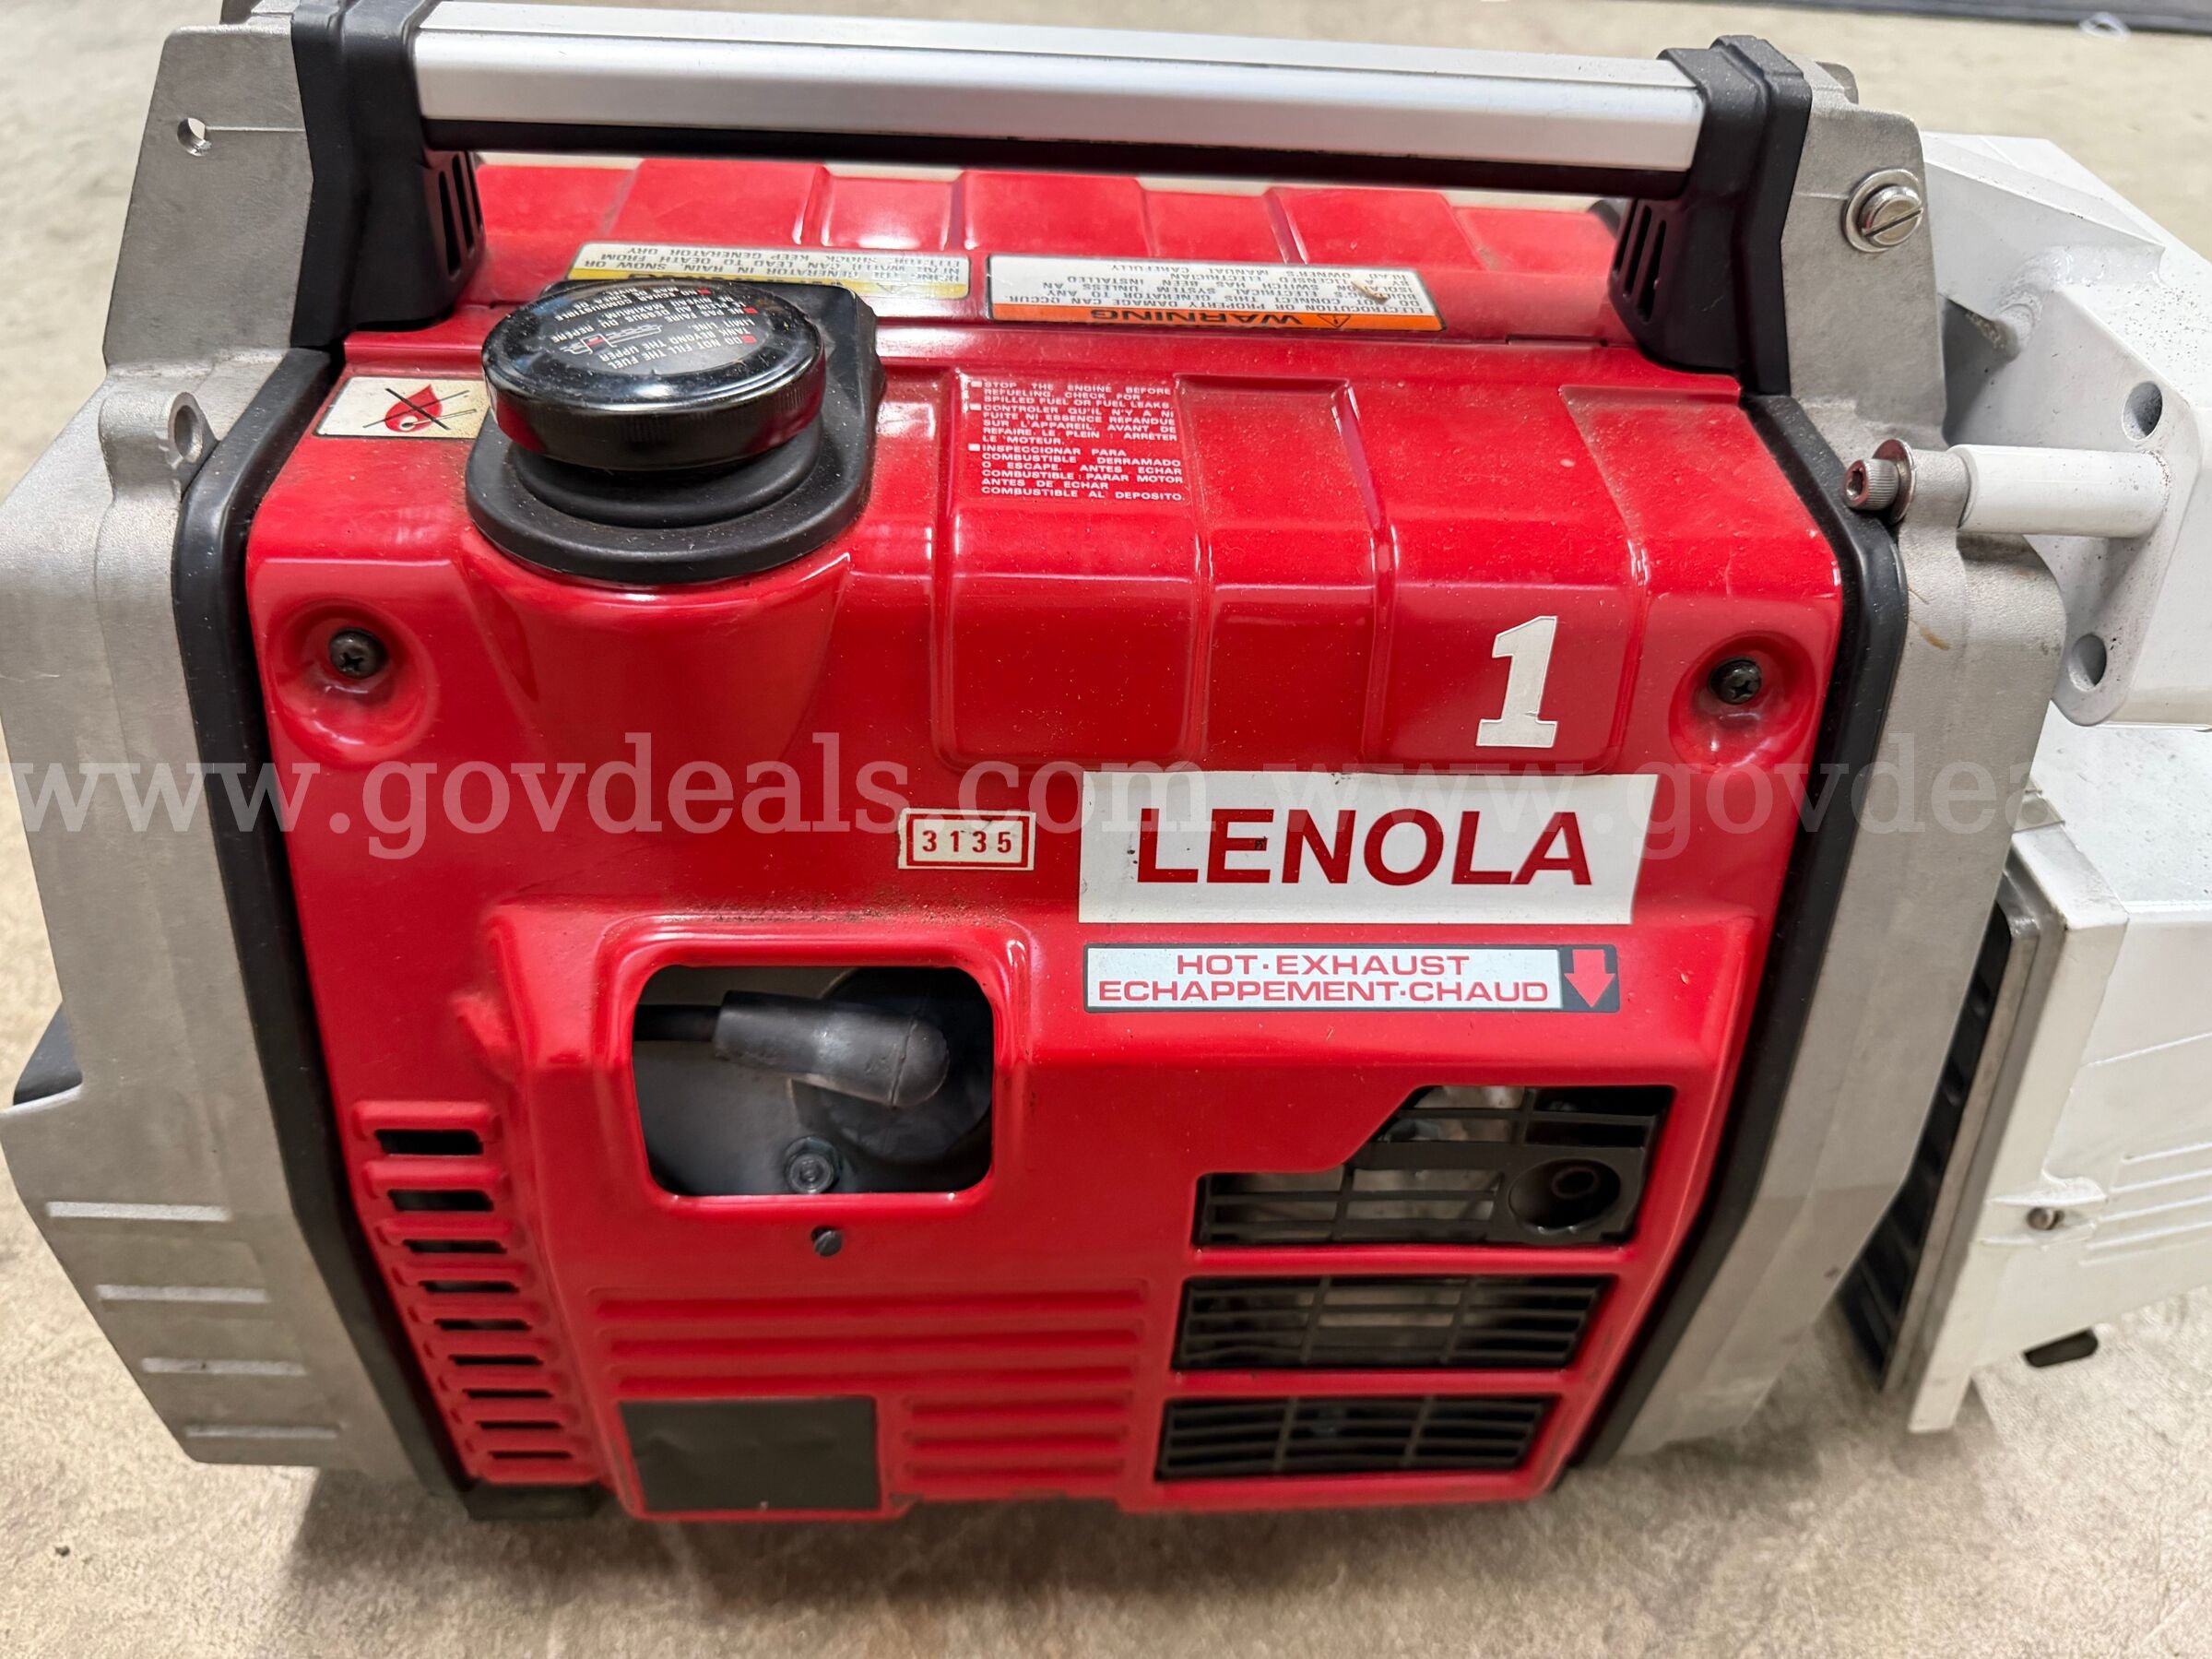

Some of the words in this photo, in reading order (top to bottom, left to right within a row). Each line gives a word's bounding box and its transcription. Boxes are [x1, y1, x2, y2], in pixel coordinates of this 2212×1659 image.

[670, 249, 762, 259] GENERATOR
[1067, 276, 1143, 284] INSTALLED
[669, 296, 713, 306] NIVEAU
[1123, 292, 1210, 301] GENERATOR
[1112, 299, 1177, 307] DAMAGE
[554, 299, 633, 321] COMBUSTIBLE
[674, 304, 692, 314] AU
[1306, 304, 1424, 314] ELECTROCUTION
[624, 308, 670, 323] DESSUS
[664, 312, 697, 323] FAIRE
[1091, 310, 1303, 325] WARNING
[688, 321, 718, 332] LINE.
[722, 318, 754, 328] LIMIT
[718, 326, 751, 336] TANK
[668, 331, 716, 345] BEYOND
[725, 336, 743, 345] DO
[642, 339, 667, 350] THE
[668, 343, 692, 354] FILL
[697, 339, 721, 350] NOT
[597, 345, 640, 361] UPPER
[641, 349, 667, 361] THE
[608, 356, 639, 369] FUEL
[984, 380, 1017, 388] STOP
[1031, 383, 1054, 391] THE
[1068, 384, 1112, 393] ENGINE
[1125, 386, 1171, 396] BEFORE
[1064, 391, 1106, 399] CHECK
[984, 396, 1035, 404] SPILLED
[1039, 397, 1069, 406] FUEL
[1130, 401, 1174, 410] LEAKS.
[983, 404, 1059, 413] CONTROLER
[1161, 410, 1174, 419] NI
[983, 411, 1018, 421] FUITE
[1046, 414, 1103, 422] ESSENCE
[1066, 430, 1099, 439] PLEIN
[983, 444, 1081, 456] INSPECCIONAR
[1092, 448, 1127, 456] PARA
[982, 453, 1077, 463] COMBUSTIBLE
[1097, 457, 1180, 467] DERRAMADO
[1080, 465, 1122, 473] ANTES
[1138, 467, 1182, 475] ECHAR
[981, 469, 1074, 480] COMBUSTIBLE
[1086, 473, 1129, 481] PARAR
[1137, 475, 1183, 483] MOTOR
[981, 478, 1025, 487] ANTES
[981, 487, 1078, 497] COMBUSTIBLE
[1475, 615, 1558, 749] 1
[922, 830, 1012, 853] 3135
[1137, 808, 1592, 886] LENOLA
